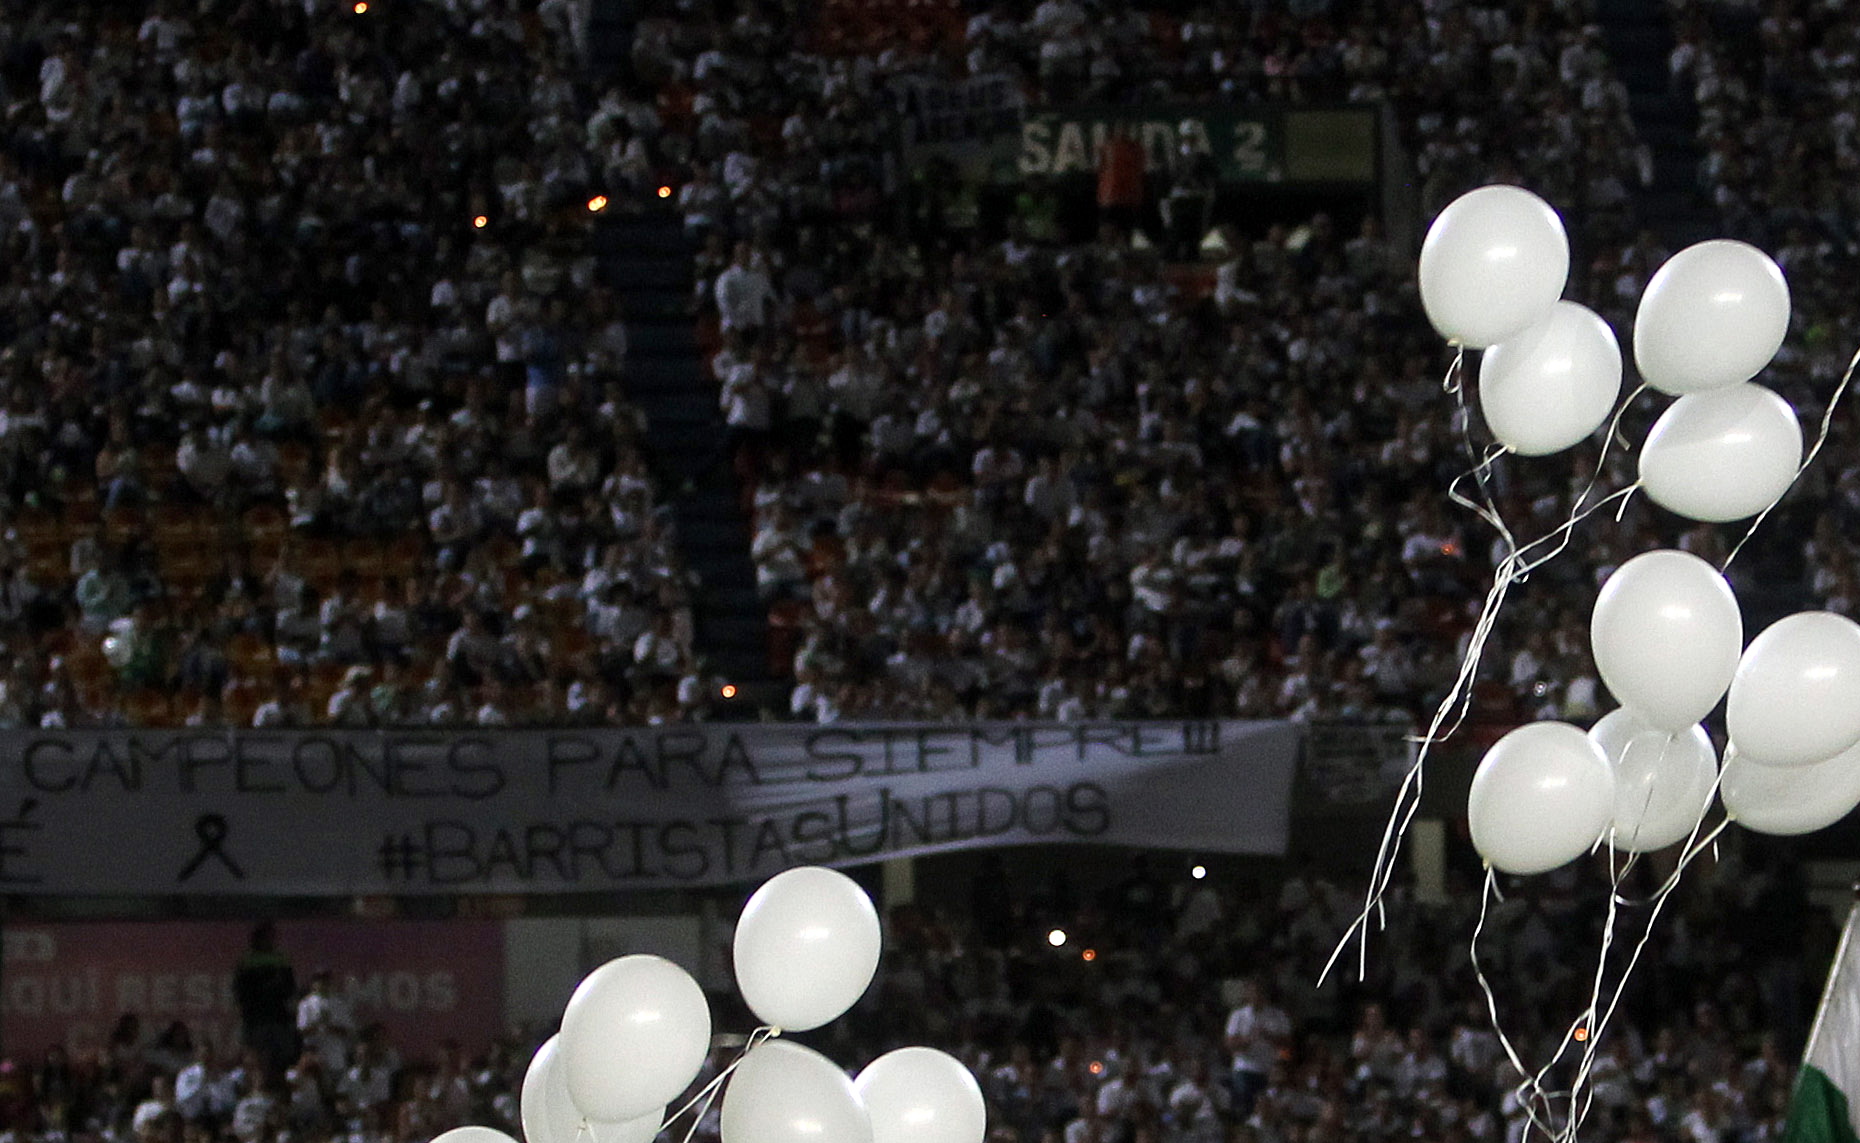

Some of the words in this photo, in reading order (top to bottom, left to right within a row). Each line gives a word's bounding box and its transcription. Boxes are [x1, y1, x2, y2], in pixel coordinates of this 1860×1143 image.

[1233, 121, 1267, 171] 2
[22, 734, 504, 799] CAMPEONES
[548, 729, 760, 793] PARA
